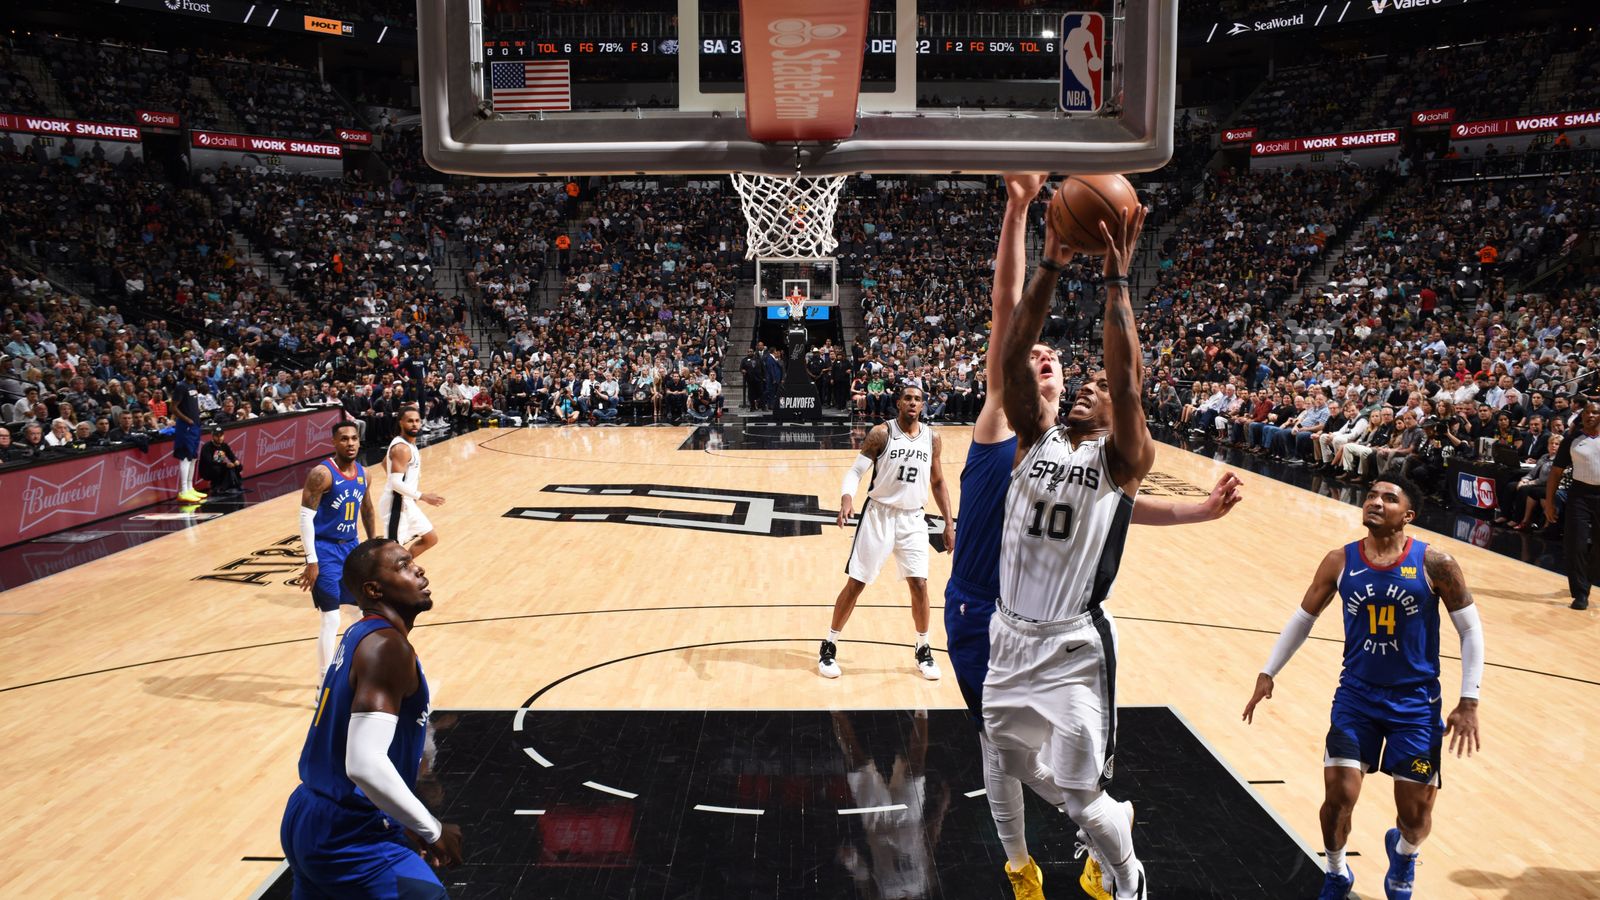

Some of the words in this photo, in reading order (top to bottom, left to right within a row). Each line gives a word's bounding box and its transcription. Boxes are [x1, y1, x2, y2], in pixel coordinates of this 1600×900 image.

[183, 0, 211, 14] Frost
[311, 20, 339, 30] HOLT
[1254, 14, 1303, 32] SeaWorld
[537, 43, 558, 53] TOL
[564, 43, 572, 53] 6
[579, 43, 594, 53] FG
[599, 43, 624, 53] 78%
[631, 42, 638, 51] F
[641, 42, 649, 52] 3
[703, 39, 726, 54] SA
[916, 40, 930, 54] 2
[946, 42, 952, 51] F
[955, 42, 963, 52] 2
[970, 42, 984, 51] FG
[989, 42, 1014, 52] 50%
[1020, 42, 1039, 52] TOL
[1046, 43, 1054, 52] 6
[1066, 90, 1087, 107] NBA
[152, 116, 174, 124] dahill
[1427, 112, 1449, 121] dahill
[26, 119, 70, 133] WORK
[76, 124, 138, 138] SMARTER
[1469, 124, 1499, 134] dahill
[1515, 117, 1558, 130] WORK
[349, 132, 367, 141] dahill
[1232, 130, 1253, 139] dahill
[1266, 142, 1290, 153] dahill
[1303, 137, 1337, 149] WORK
[1341, 132, 1396, 146] SMARTER
[211, 136, 237, 147] dahill
[251, 138, 286, 151] WORK
[290, 142, 340, 156] SMARTER
[785, 397, 815, 409] PLAYOFFS
[256, 434, 296, 457] Budweiser
[890, 448, 928, 462] SPURS
[120, 462, 180, 490] Budweiser
[897, 465, 918, 483] 12
[1029, 460, 1100, 492] SPURS
[1460, 479, 1473, 499] NBA
[23, 482, 100, 515] Budweiser
[331, 489, 350, 510] MILE
[353, 488, 364, 505] HIG
[344, 502, 355, 521] 11
[337, 522, 356, 533] CITY
[1028, 501, 1073, 540] 10
[1347, 583, 1375, 616] MILE
[1386, 584, 1419, 616] HIGH
[1366, 604, 1396, 635] 14
[1363, 639, 1399, 655] CITY
